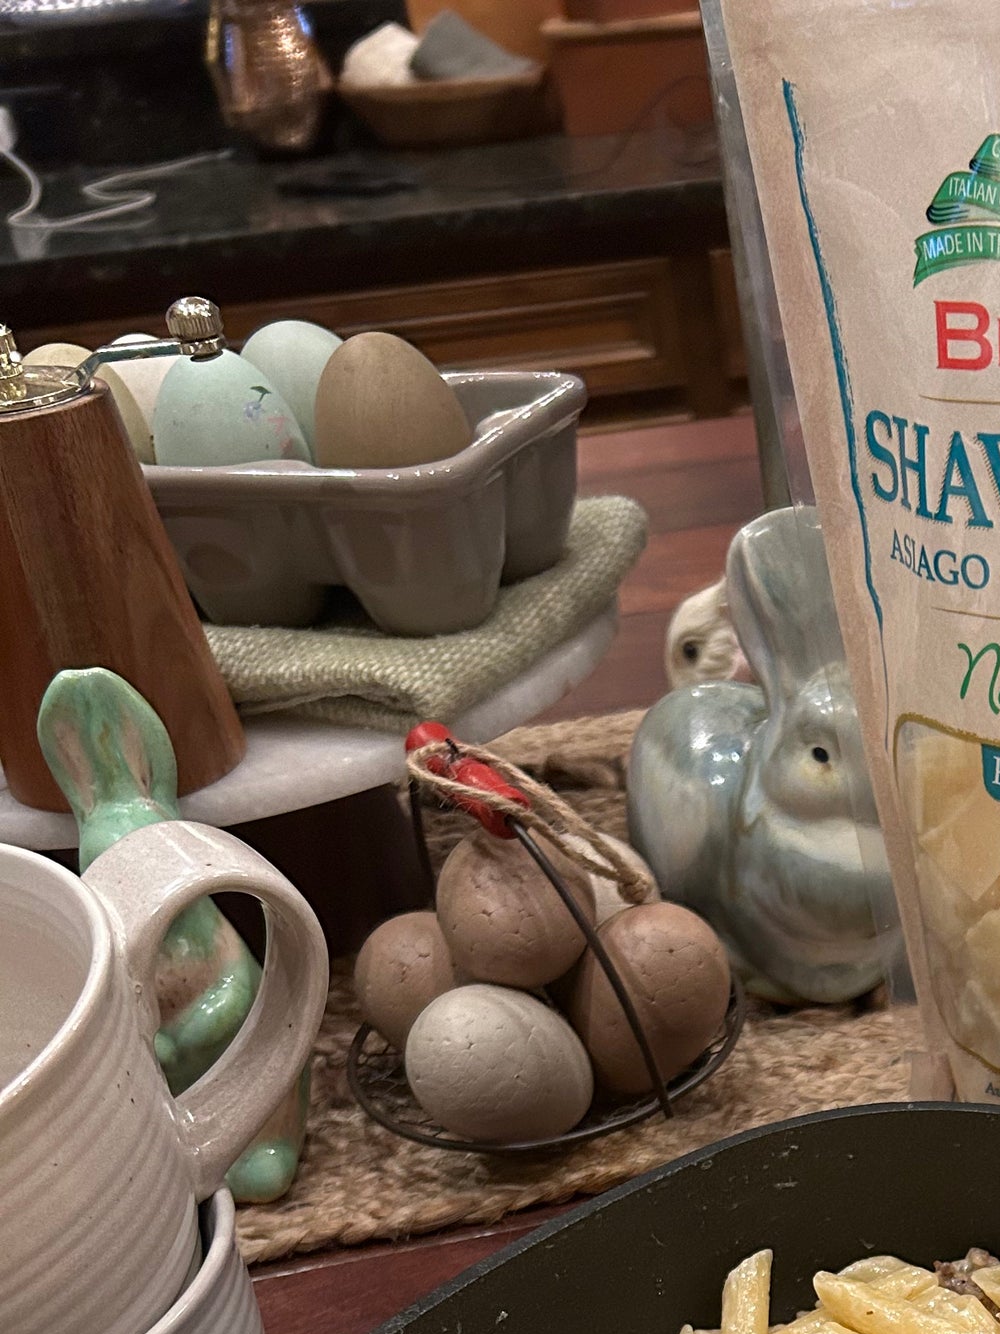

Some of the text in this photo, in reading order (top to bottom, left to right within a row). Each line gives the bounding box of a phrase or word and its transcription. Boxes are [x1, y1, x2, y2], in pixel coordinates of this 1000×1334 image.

[949, 177, 997, 205] ITALIAN
[923, 233, 963, 261] MADE
[967, 233, 983, 253] IN
[891, 528, 991, 591] ASIAGO
